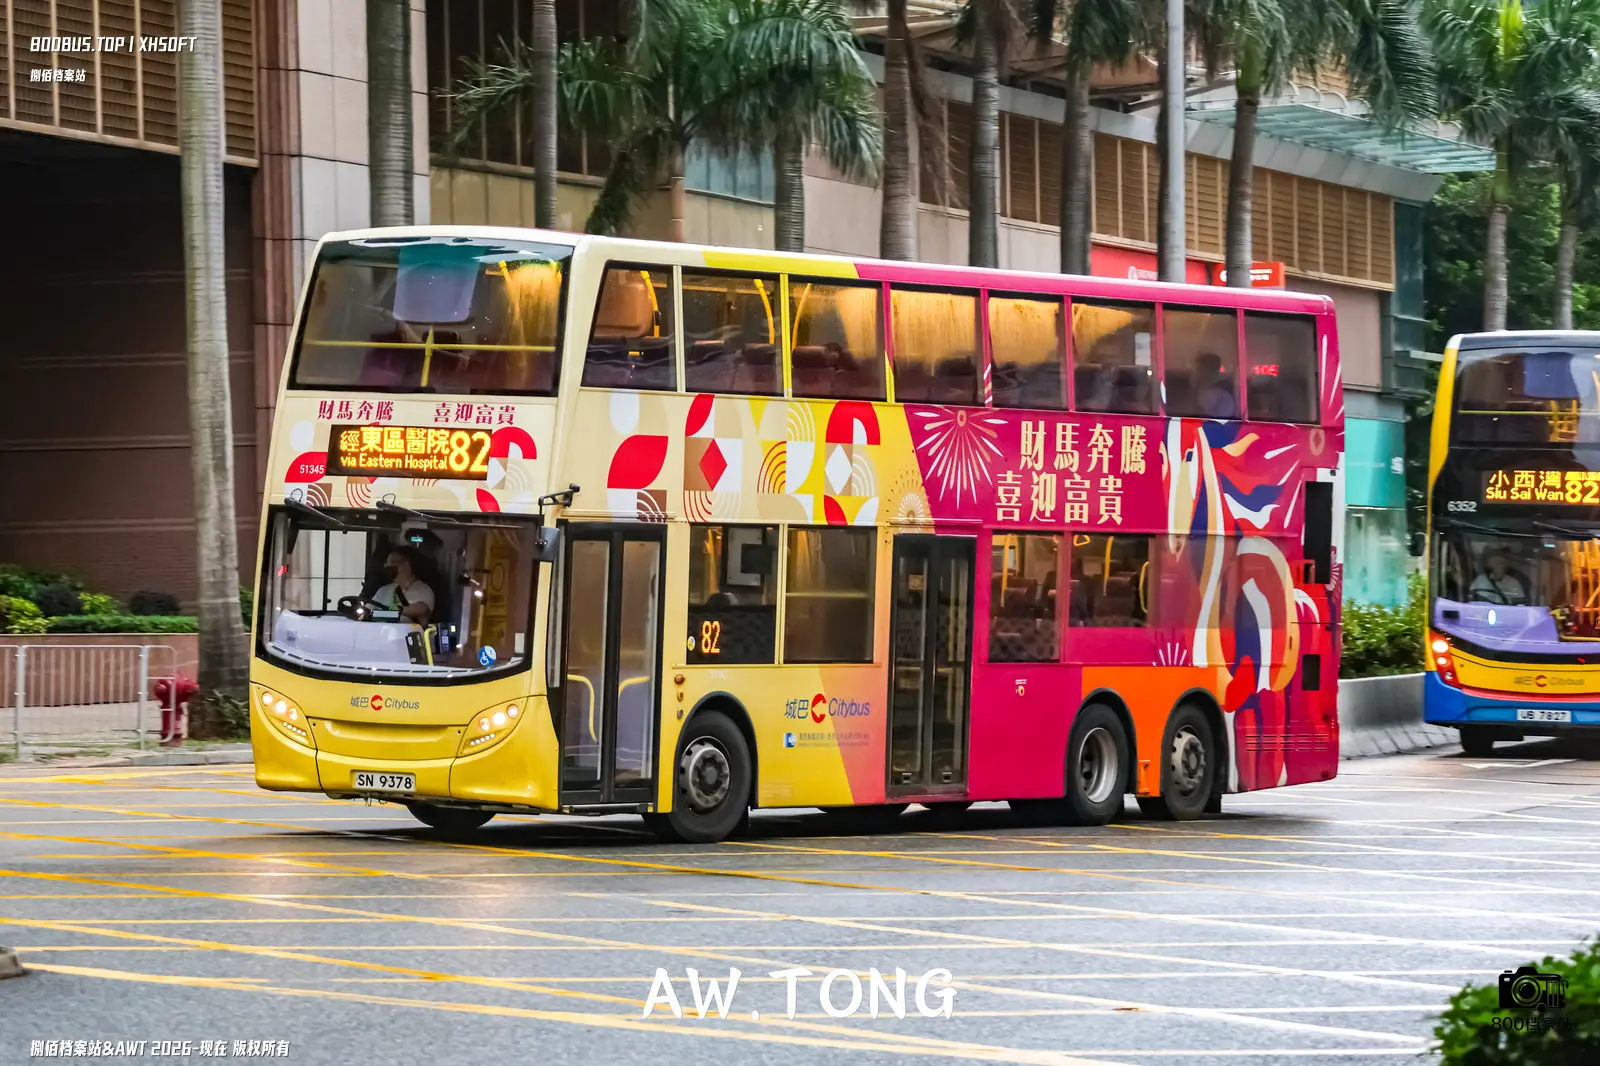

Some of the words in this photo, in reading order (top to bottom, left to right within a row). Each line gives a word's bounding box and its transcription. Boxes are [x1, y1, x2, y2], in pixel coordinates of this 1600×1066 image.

[317, 400, 394, 421] 財馬奔騰
[432, 403, 516, 426] 喜迎富貴
[339, 426, 450, 454] 經東區醫院
[1019, 420, 1147, 475] 財馬奔騰
[448, 430, 491, 473] 82
[299, 464, 325, 475] 51345
[341, 455, 356, 467] via
[359, 456, 402, 469] Eastern
[405, 456, 448, 472] Hospital
[1489, 470, 1562, 489] 小西灣
[995, 470, 1124, 525] 喜迎富貴
[1486, 487, 1507, 500] Siu
[1510, 487, 1531, 500] Sai
[1534, 488, 1564, 501] Wan
[1564, 480, 1600, 504] 82
[1447, 501, 1477, 512] 6352
[701, 621, 720, 654] 82
[350, 696, 369, 708] 城巴
[384, 698, 420, 710] Citybus
[784, 698, 809, 719] 城巴
[828, 697, 870, 718] Citybus
[1520, 710, 1535, 720] UB
[1539, 711, 1568, 721] 7827
[358, 774, 374, 787] SN
[379, 775, 413, 789] 9378
